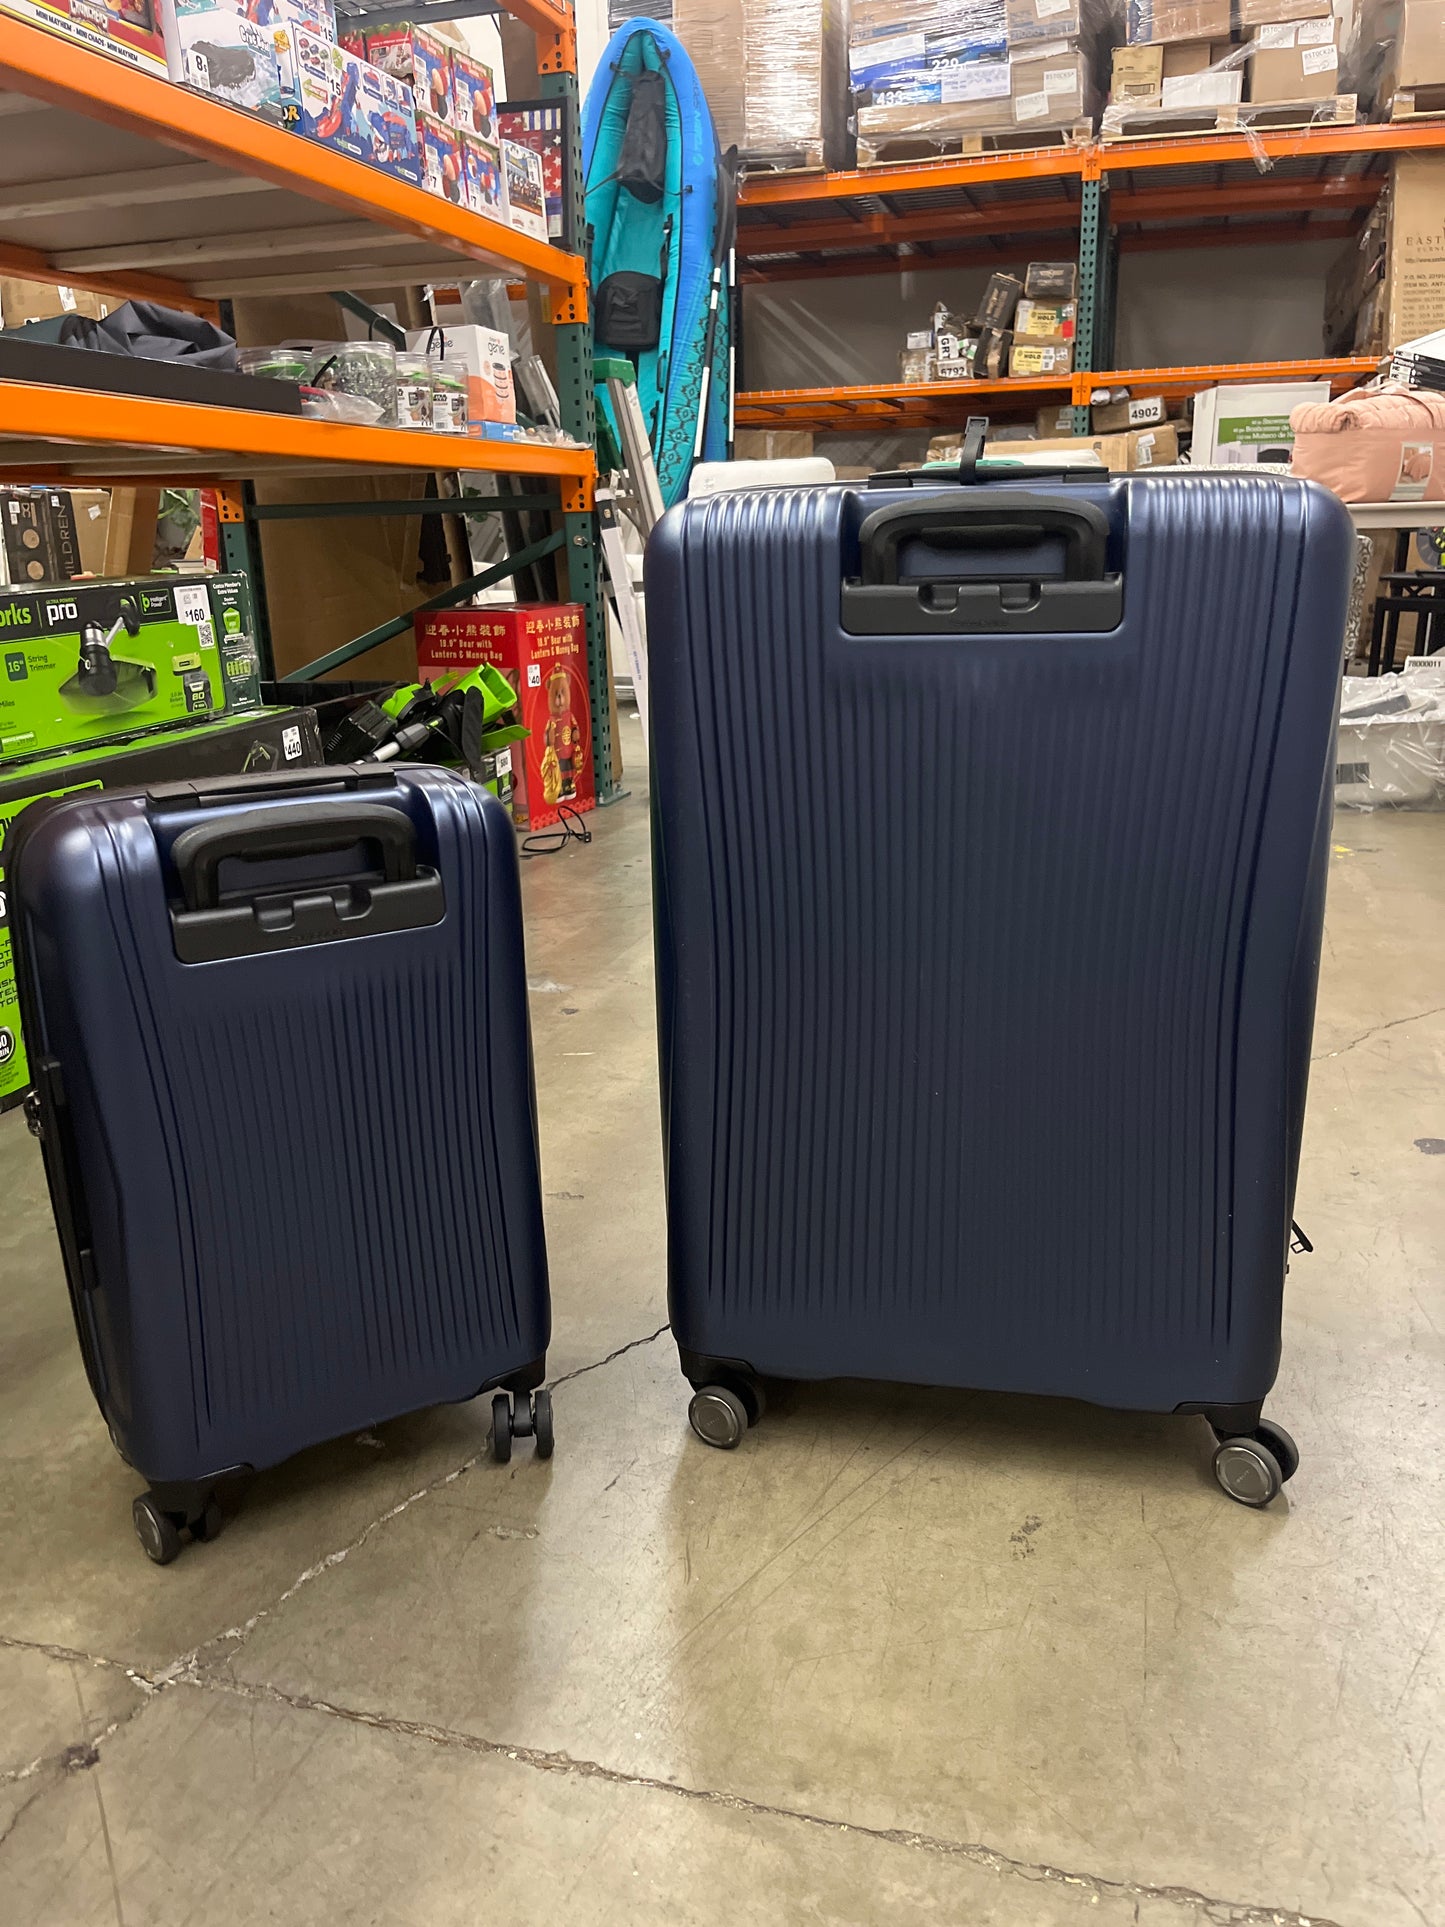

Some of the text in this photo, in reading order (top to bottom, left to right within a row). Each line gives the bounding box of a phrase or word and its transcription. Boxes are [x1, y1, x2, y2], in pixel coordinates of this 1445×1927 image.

[36, 9, 138, 62] MINI MAYHEM MINI CHAOS MINI MAYHEM
[1131, 406, 1159, 420] 4902
[46, 603, 78, 626] pro
[185, 608, 205, 622] $160
[459, 639, 474, 648] Bear
[477, 639, 492, 648] with
[431, 650, 457, 659] Lantern
[466, 650, 488, 661] Money
[490, 651, 502, 661] Bag
[531, 648, 550, 660] Lantern
[8, 654, 48, 673] 16" String
[29, 662, 56, 672] Trimmer
